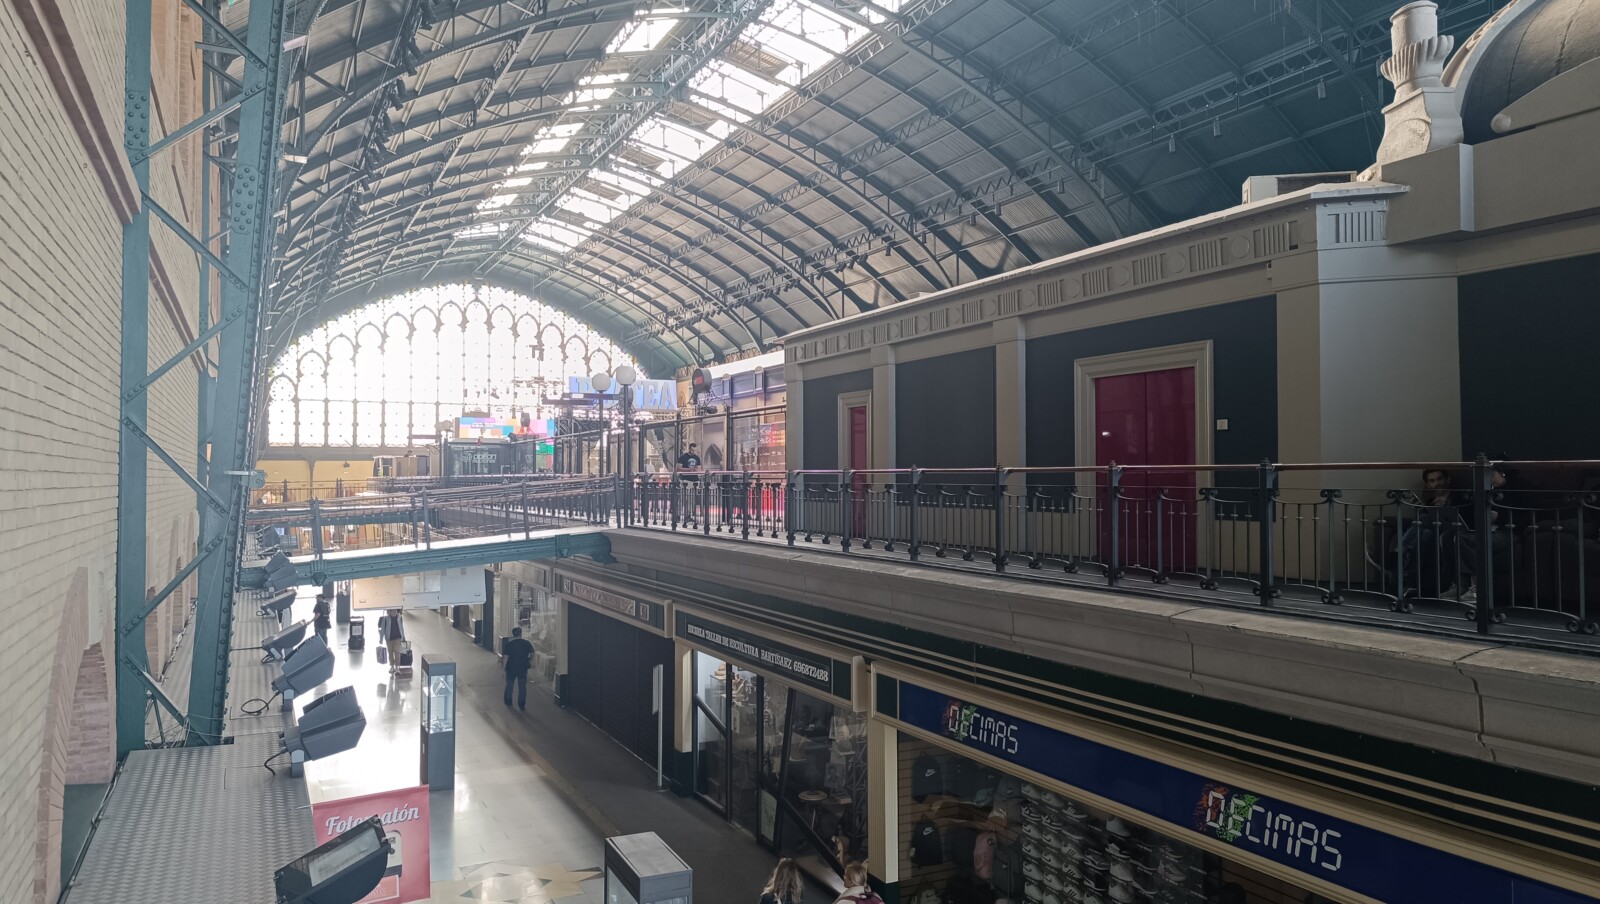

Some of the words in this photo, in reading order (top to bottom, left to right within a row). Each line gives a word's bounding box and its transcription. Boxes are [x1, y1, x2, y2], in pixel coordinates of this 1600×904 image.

[722, 636, 729, 647] DE
[729, 638, 759, 658] ESCULTURA
[948, 705, 1019, 755] DECIMAS
[325, 803, 420, 836] Fotoatón
[1206, 790, 1342, 872] DECIMAS
